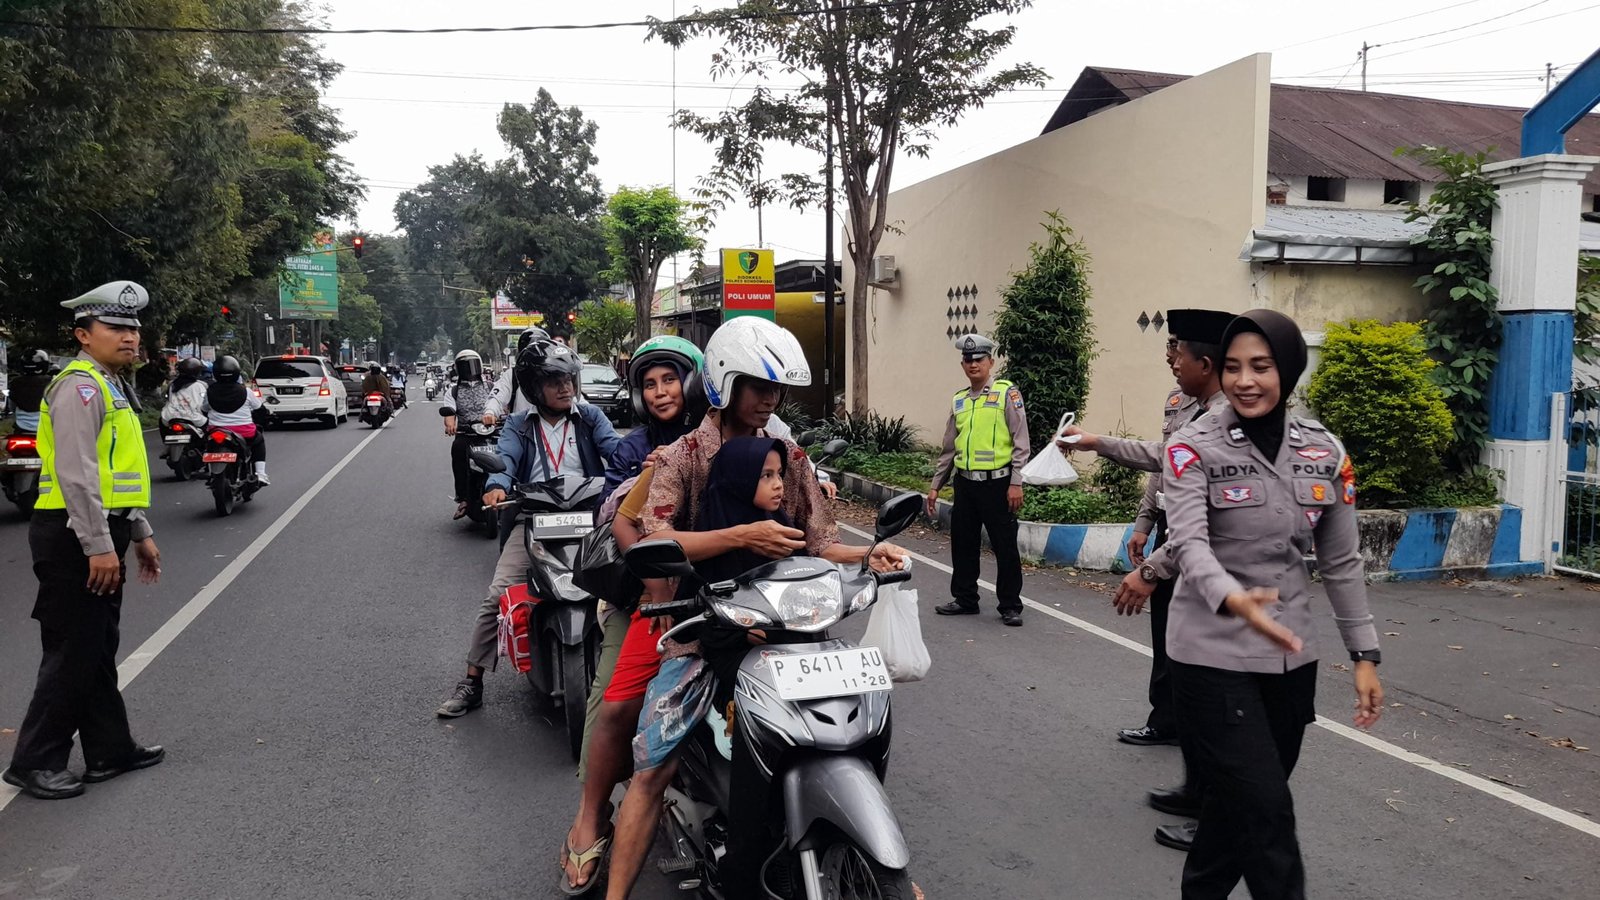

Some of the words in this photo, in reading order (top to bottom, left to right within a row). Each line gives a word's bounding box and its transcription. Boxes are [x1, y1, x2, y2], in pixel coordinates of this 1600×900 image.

[1209, 464, 1259, 479] LIDYA
[1293, 464, 1336, 477] POLRI
[538, 517, 544, 527] N
[556, 515, 583, 526] 5428
[783, 567, 816, 576] HONDA
[774, 660, 784, 677] P
[800, 655, 843, 675] 6411
[860, 650, 882, 669] AU
